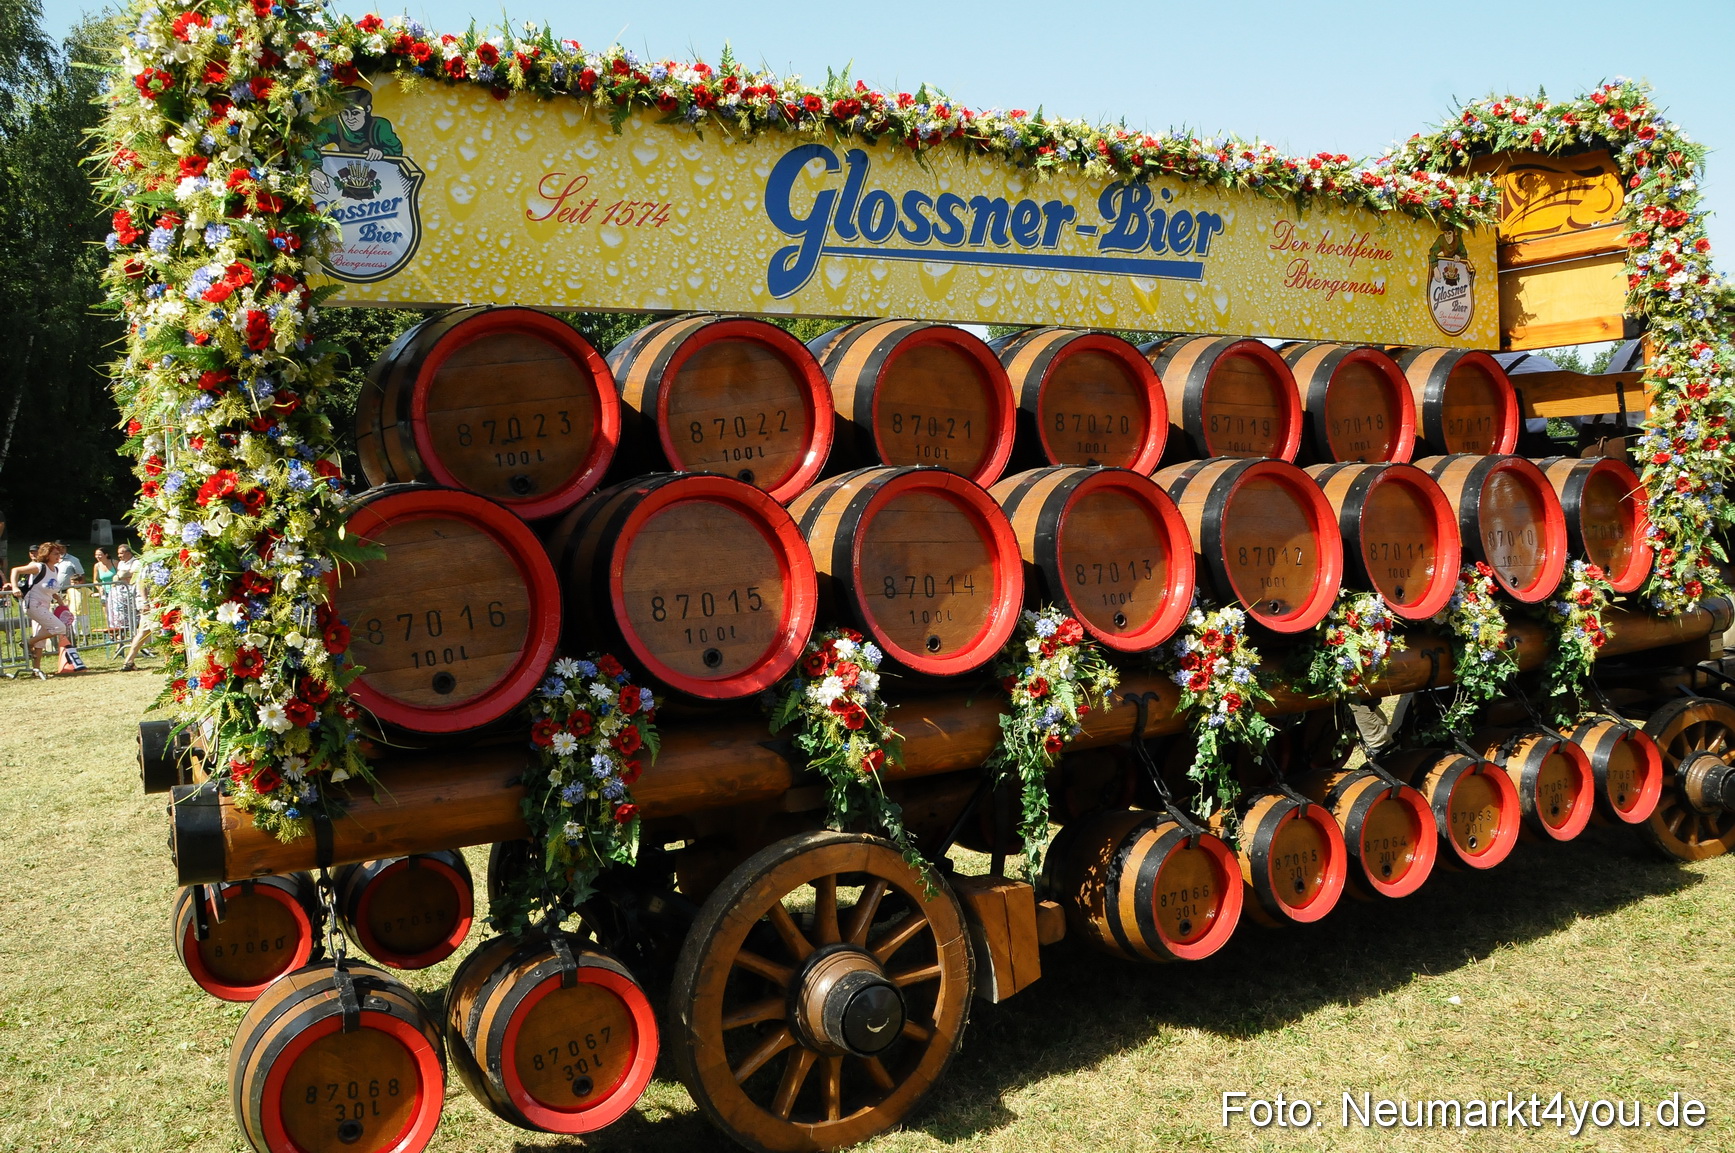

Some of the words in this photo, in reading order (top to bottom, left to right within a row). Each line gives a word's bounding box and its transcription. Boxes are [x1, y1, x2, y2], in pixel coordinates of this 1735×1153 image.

[315, 196, 403, 222] ossner
[526, 172, 598, 224] Seit
[601, 200, 672, 229] 1574
[359, 221, 403, 243] Bier
[764, 144, 1223, 300] Glossner-Bier
[347, 244, 393, 258] hochfeine
[1269, 219, 1312, 252] Der
[1316, 229, 1394, 268] hochfeine
[330, 254, 388, 271] Biergenuss
[1283, 257, 1386, 302] Biergenuss
[1433, 284, 1468, 312] Glossner
[1451, 299, 1468, 313] Bier
[456, 410, 573, 447] 87023
[689, 409, 790, 444] 87022
[892, 413, 972, 440] 87021
[1055, 412, 1130, 435] 87020
[1210, 415, 1271, 438] 87019
[1331, 413, 1385, 438] 87018
[1447, 415, 1492, 436] 87017
[1487, 529, 1534, 548] 87010
[1237, 546, 1303, 567] 87012
[1369, 542, 1426, 561] 87011
[1074, 559, 1153, 586] 87013
[883, 573, 975, 600] 87014
[650, 586, 763, 623] 87015
[366, 600, 507, 646] 87016
[1537, 777, 1569, 798] 87062
[1452, 809, 1492, 824] 87063
[1364, 835, 1408, 853] 87064
[1275, 849, 1318, 871] 87065
[1160, 884, 1209, 908] 87066
[214, 934, 285, 958] 87060
[533, 1025, 611, 1072] 87067
[306, 1078, 401, 1105] 87068
